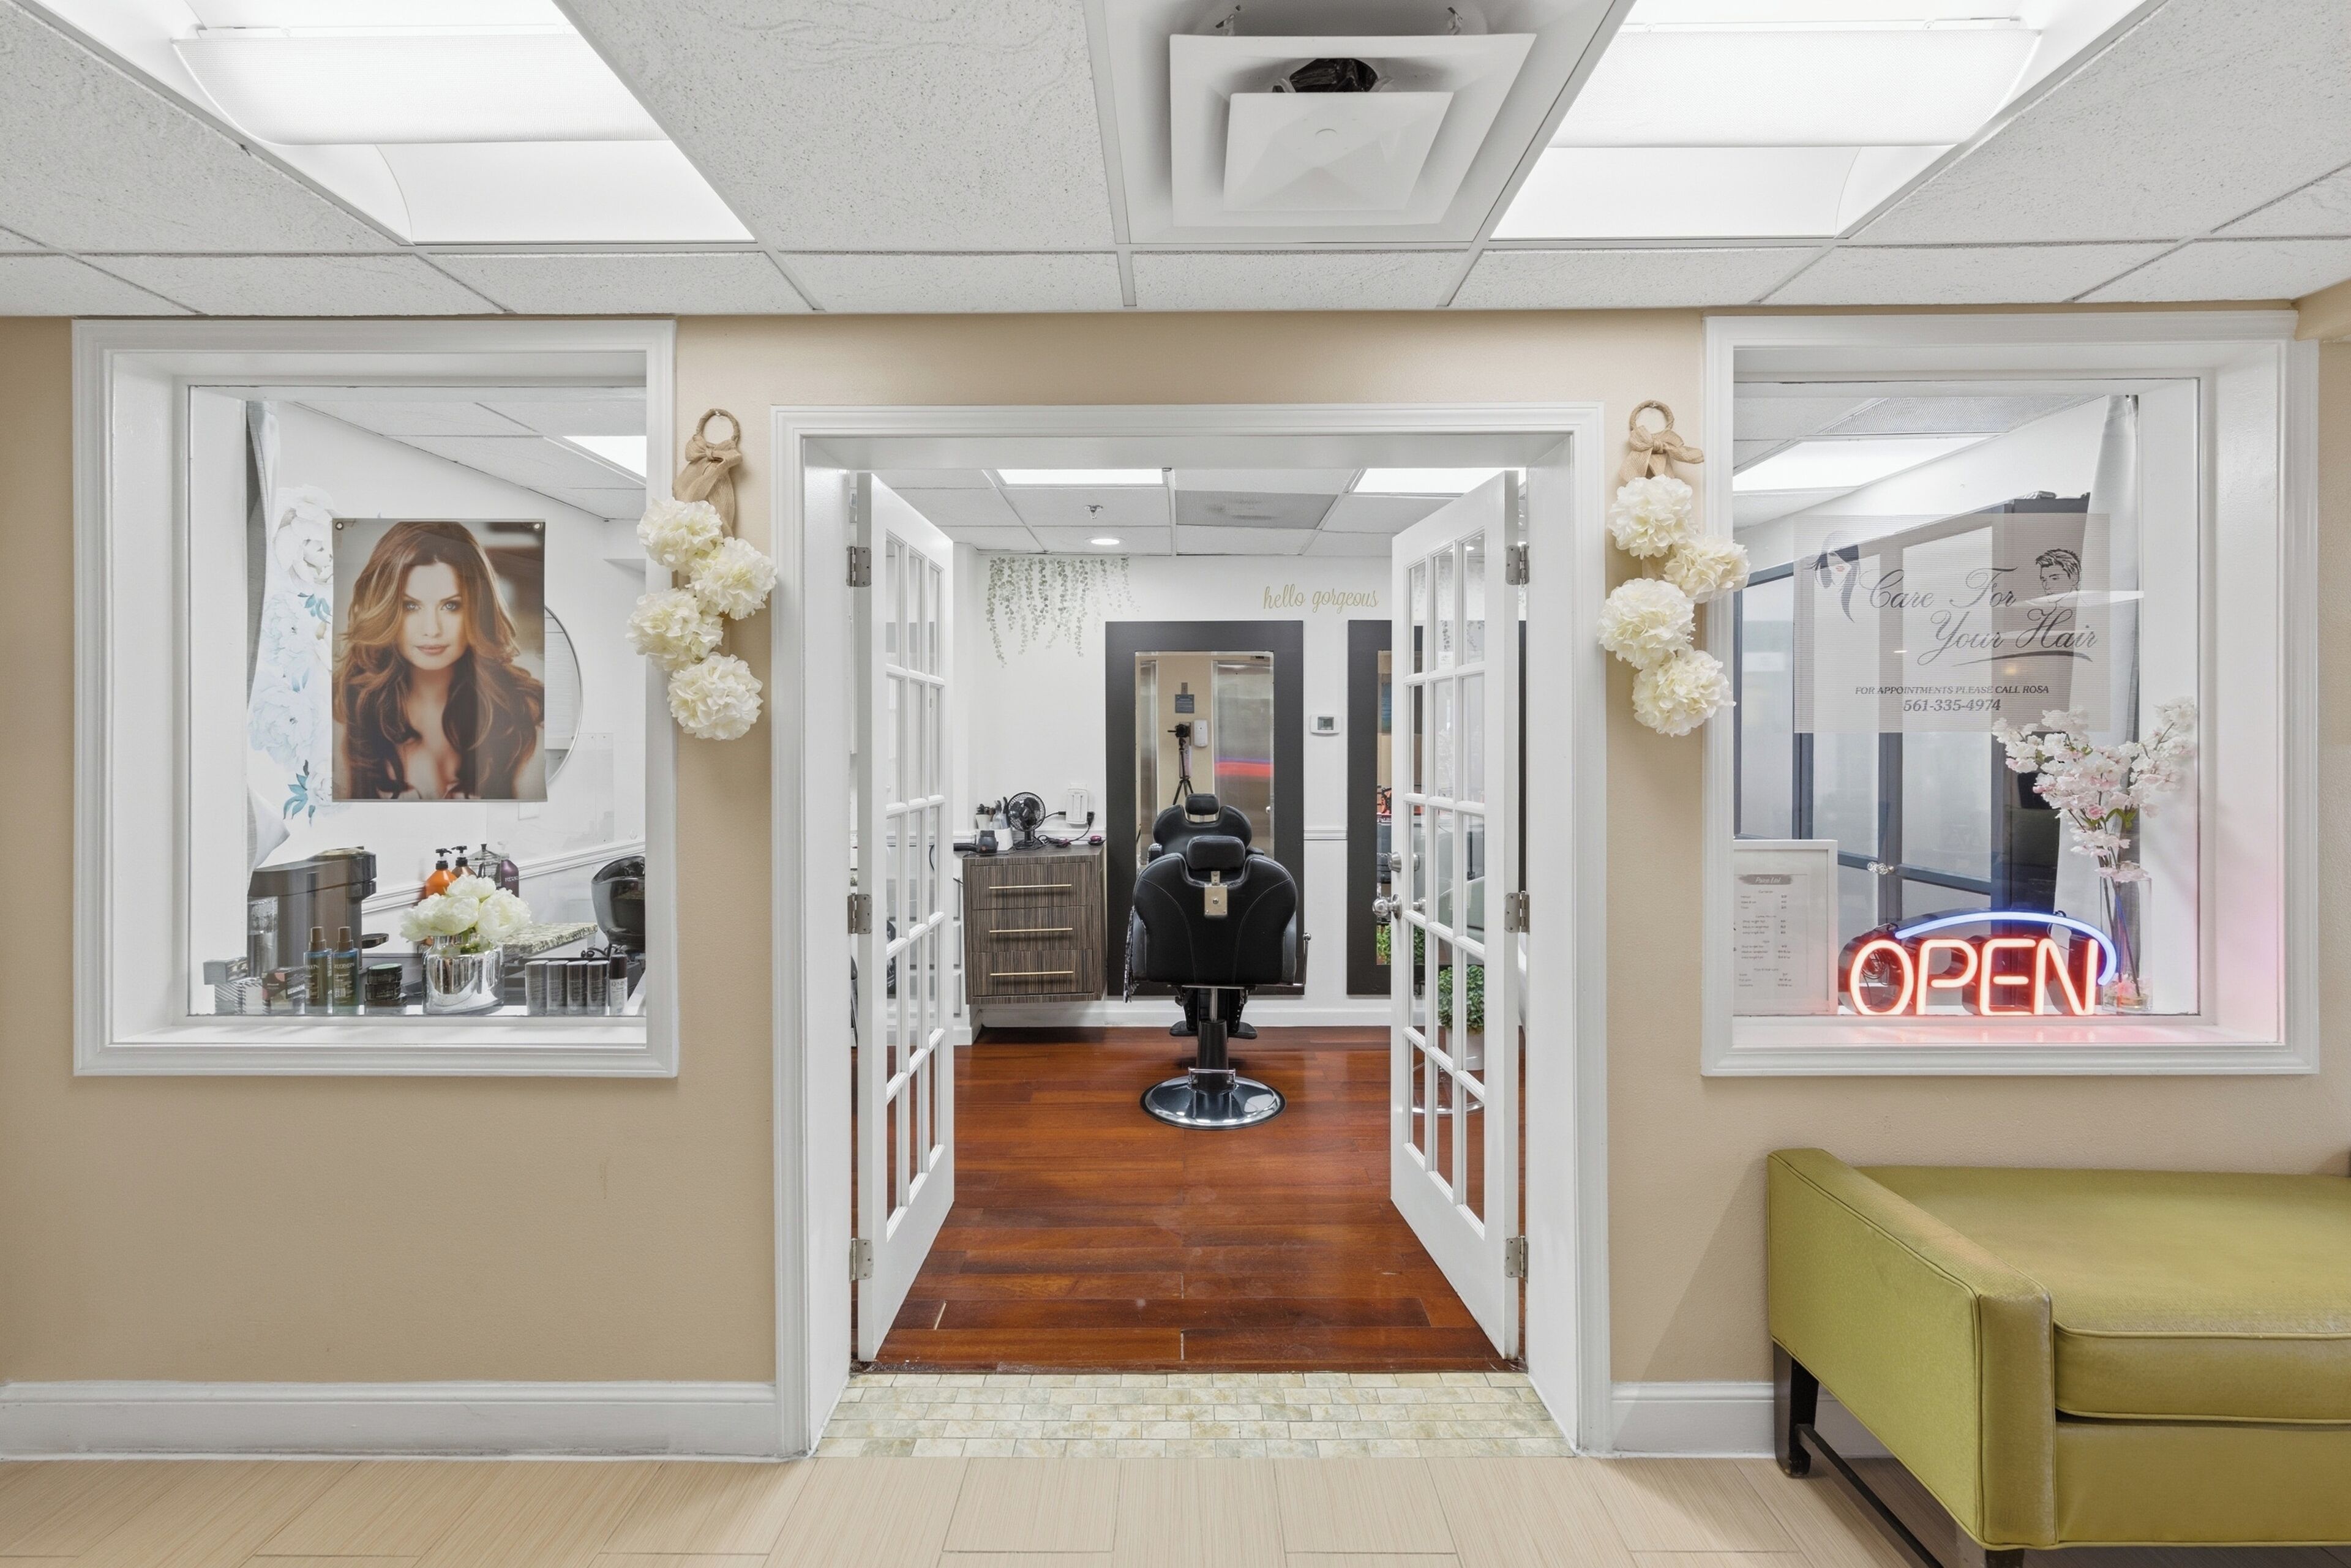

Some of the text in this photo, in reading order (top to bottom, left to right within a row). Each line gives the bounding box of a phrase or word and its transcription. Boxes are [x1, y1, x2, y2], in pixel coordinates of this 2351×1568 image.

[1263, 583, 1379, 614] hello gorgeous
[1859, 566, 2019, 609] Care For
[1917, 608, 2098, 666] Your Hair
[1903, 699, 2001, 711] 561-335-4974
[1995, 685, 2020, 694] CALL
[2022, 685, 2049, 694] ROSA
[1850, 938, 2099, 1016] OPEN
